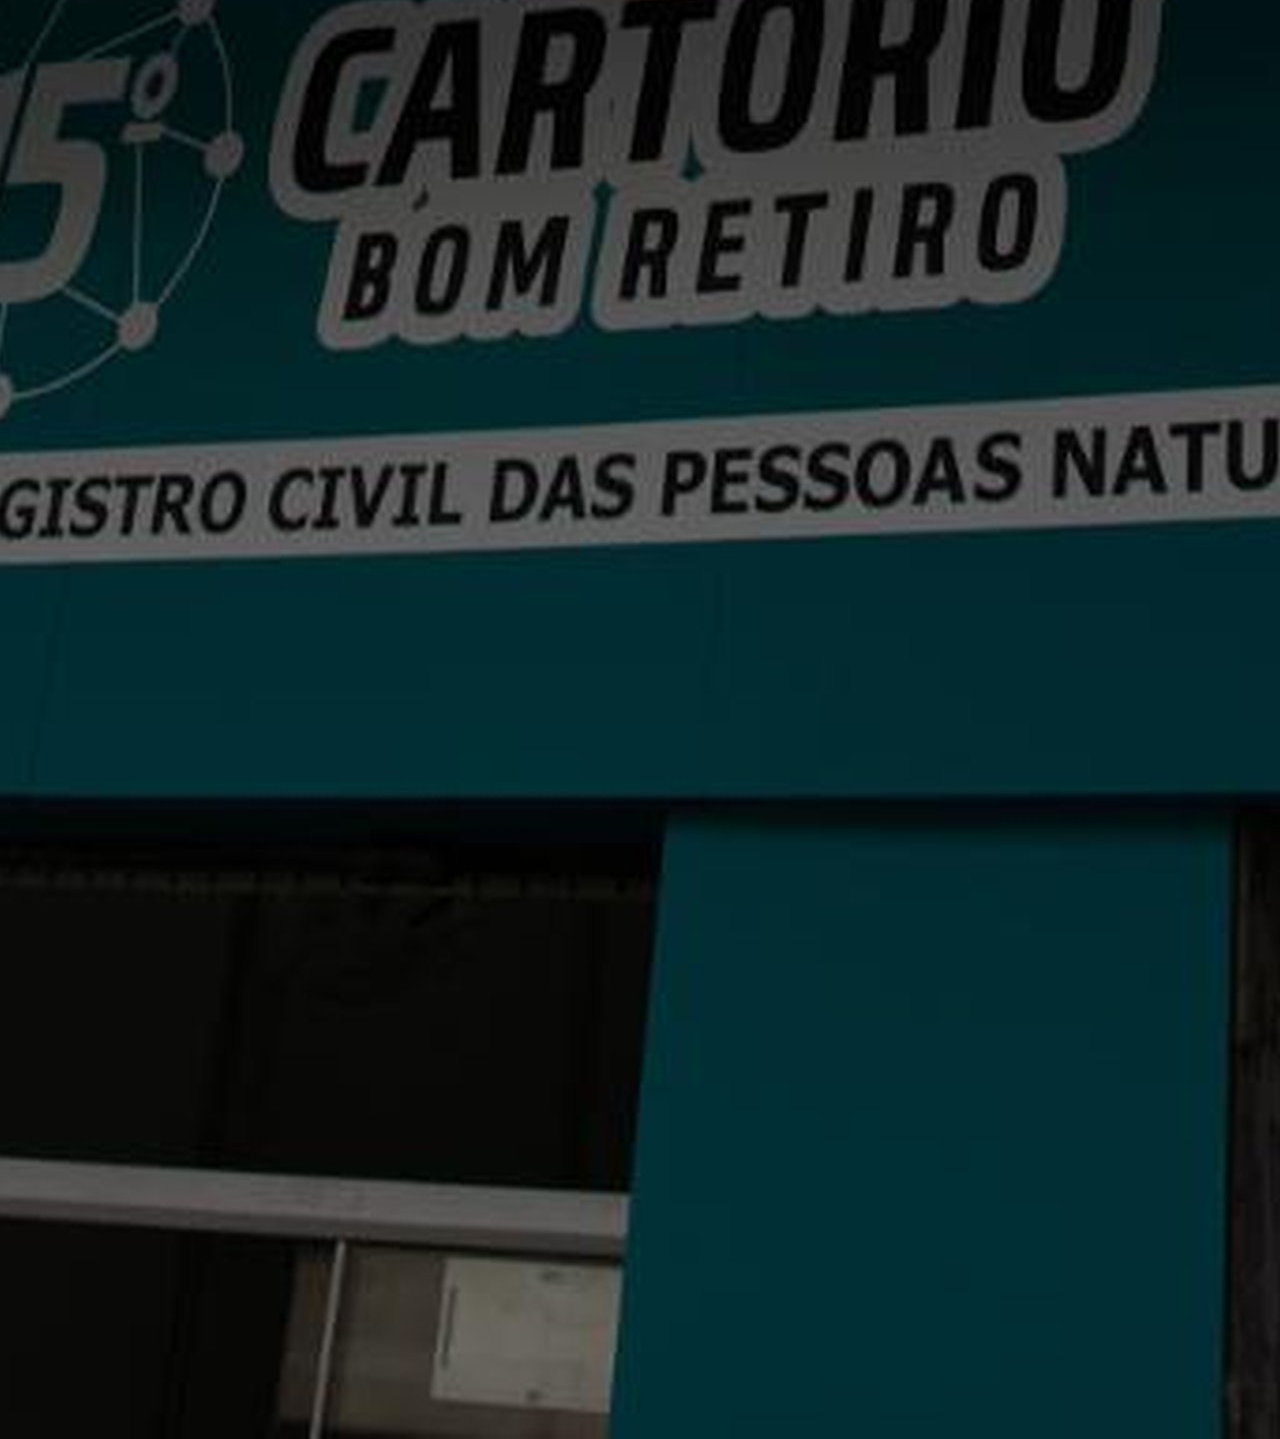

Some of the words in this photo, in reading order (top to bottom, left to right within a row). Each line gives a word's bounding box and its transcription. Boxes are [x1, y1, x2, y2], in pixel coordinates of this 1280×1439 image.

[342, 214, 571, 323] BOM
[619, 173, 1040, 302] RETIRO
[268, 461, 463, 532] CIVIL
[488, 452, 637, 524] DAS
[660, 430, 1023, 517] PESSOAS
